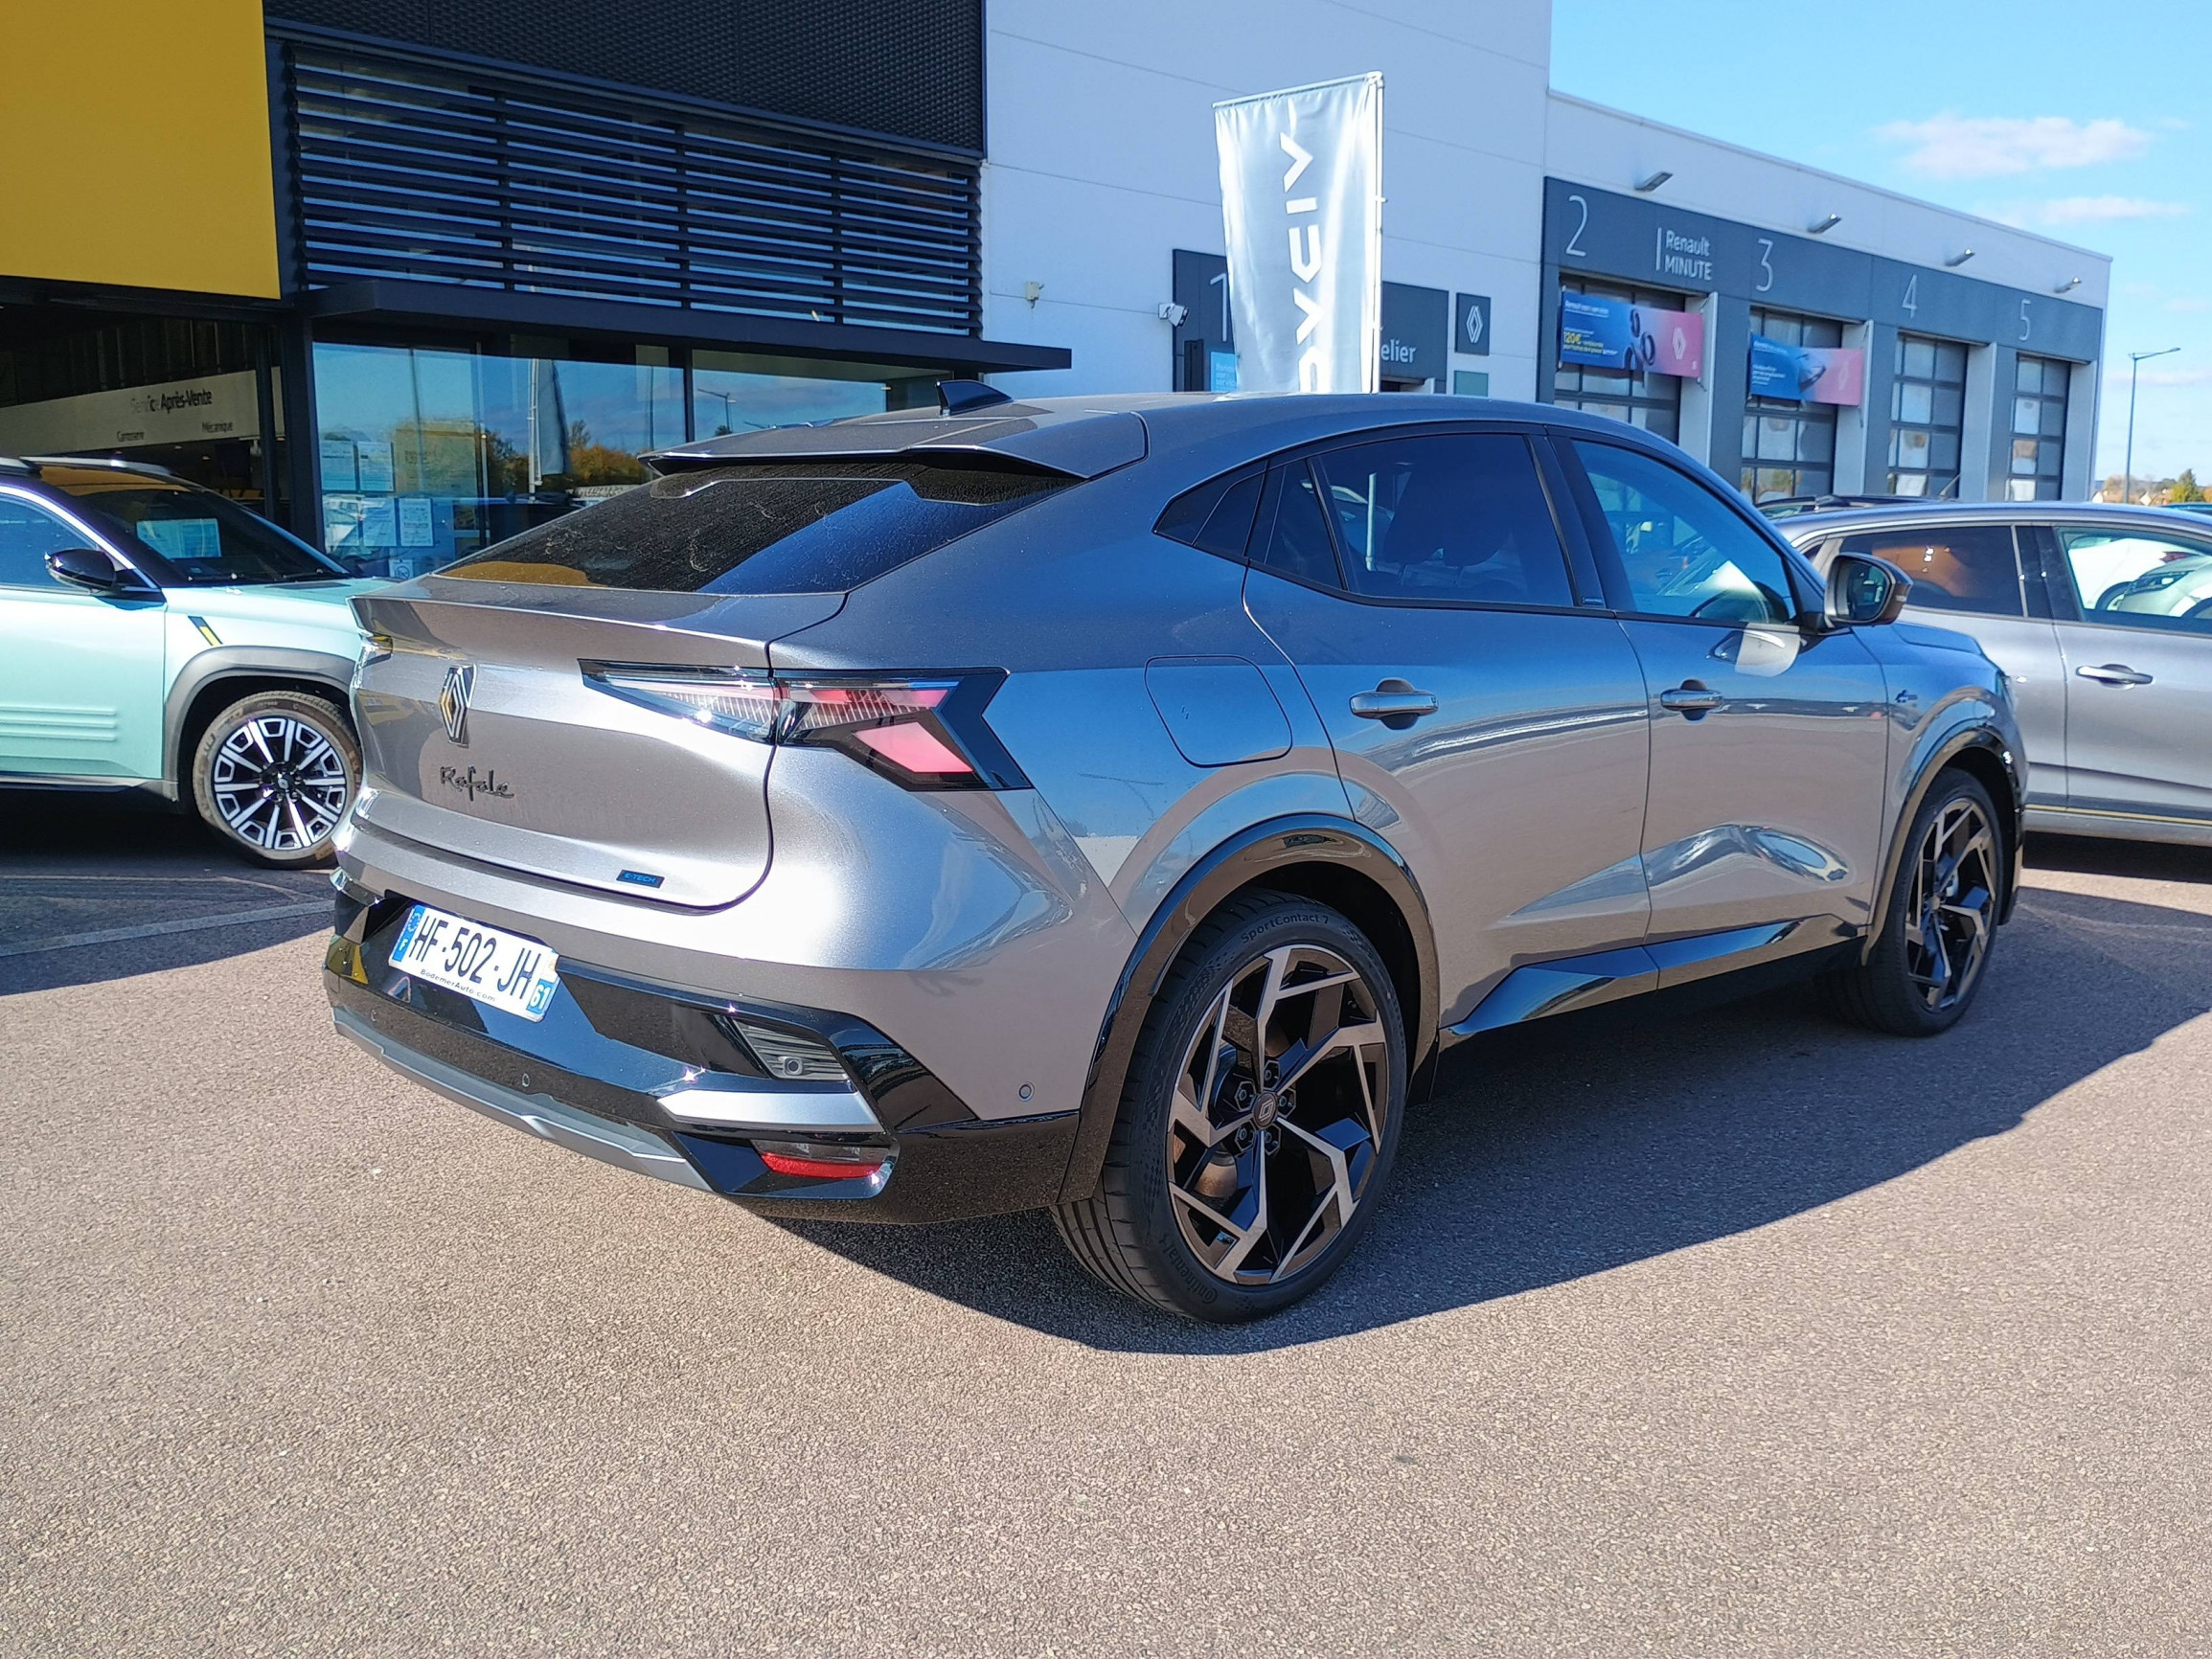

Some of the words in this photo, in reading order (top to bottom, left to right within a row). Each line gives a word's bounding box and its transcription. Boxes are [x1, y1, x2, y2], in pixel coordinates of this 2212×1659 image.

[1565, 194, 1588, 258] 2
[1665, 229, 1710, 257] Renault
[1664, 254, 1713, 281] MINUTE
[1755, 239, 1774, 292] 3
[1902, 273, 1918, 319] 4
[2018, 298, 2032, 341] 5
[1380, 337, 1418, 363] elier
[160, 388, 214, 414] Après-Vente
[440, 763, 514, 802] Rafale
[625, 872, 656, 884] E-TECH
[1241, 913, 1320, 943] SportContact
[1322, 915, 1330, 924] 7
[398, 938, 408, 952] F
[530, 984, 552, 1010] 61
